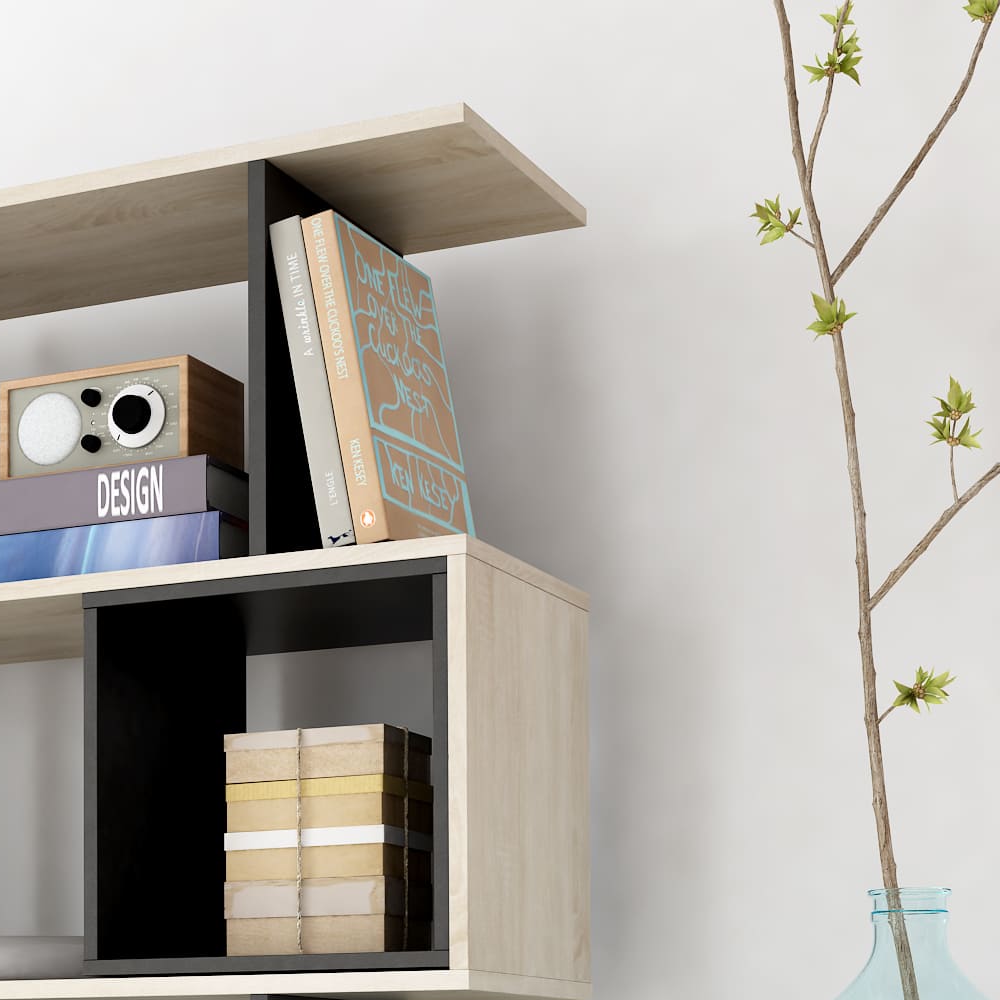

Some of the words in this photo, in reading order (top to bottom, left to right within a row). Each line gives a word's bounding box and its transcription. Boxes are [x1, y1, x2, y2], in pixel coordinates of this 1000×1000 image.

[310, 217, 322, 238] ONE
[314, 238, 327, 263] FLEW
[286, 252, 301, 282] TIME
[319, 264, 331, 289] OVER
[292, 283, 304, 298] IN
[324, 289, 336, 308] THE
[295, 299, 311, 343] wrinkle
[334, 356, 348, 380] NEST
[350, 438, 361, 459] KEN
[353, 459, 368, 486] KESEY
[97, 463, 164, 518] DESIGN
